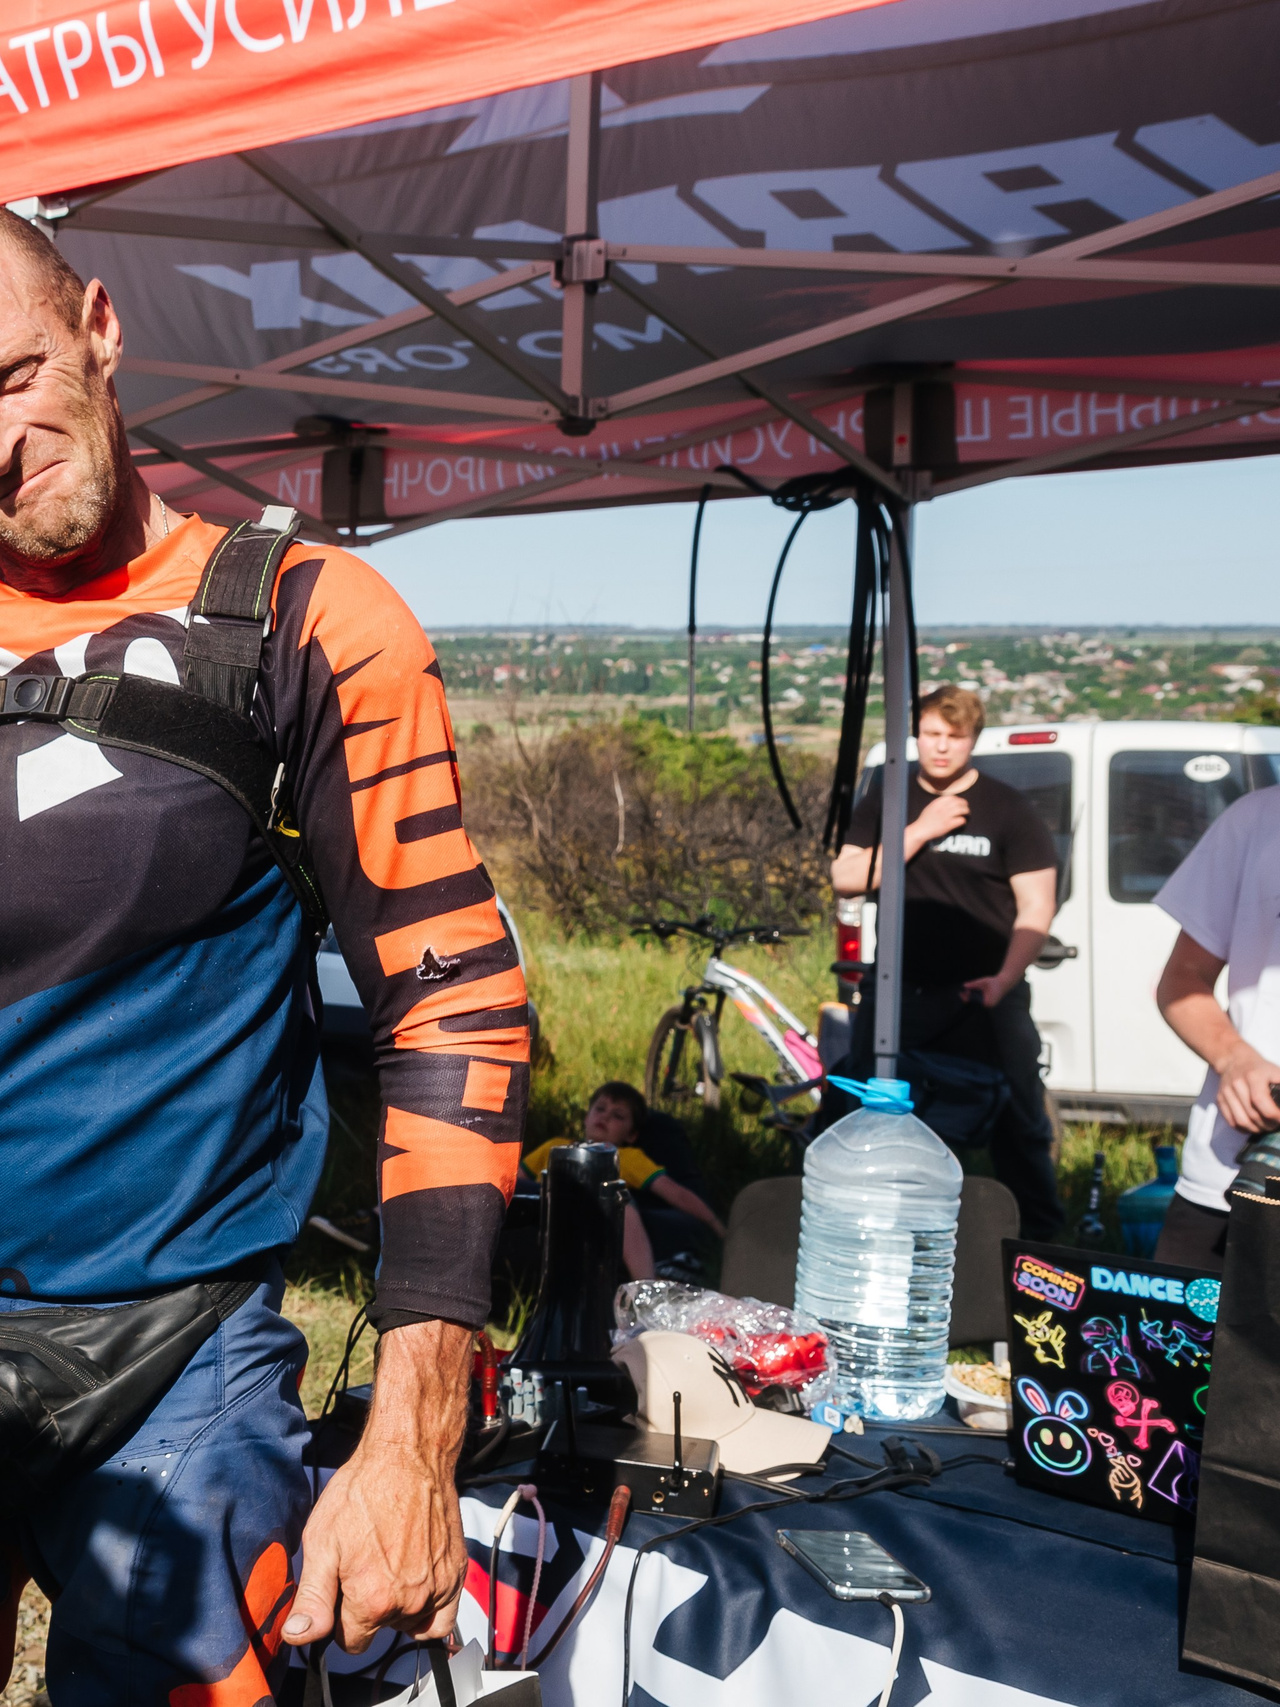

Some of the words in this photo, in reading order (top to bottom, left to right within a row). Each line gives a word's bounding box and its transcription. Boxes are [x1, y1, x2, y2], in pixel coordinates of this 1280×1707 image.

[1017, 1271, 1075, 1307] SOON
[1021, 1260, 1077, 1292] COMING
[1090, 1265, 1185, 1304] DANCE
